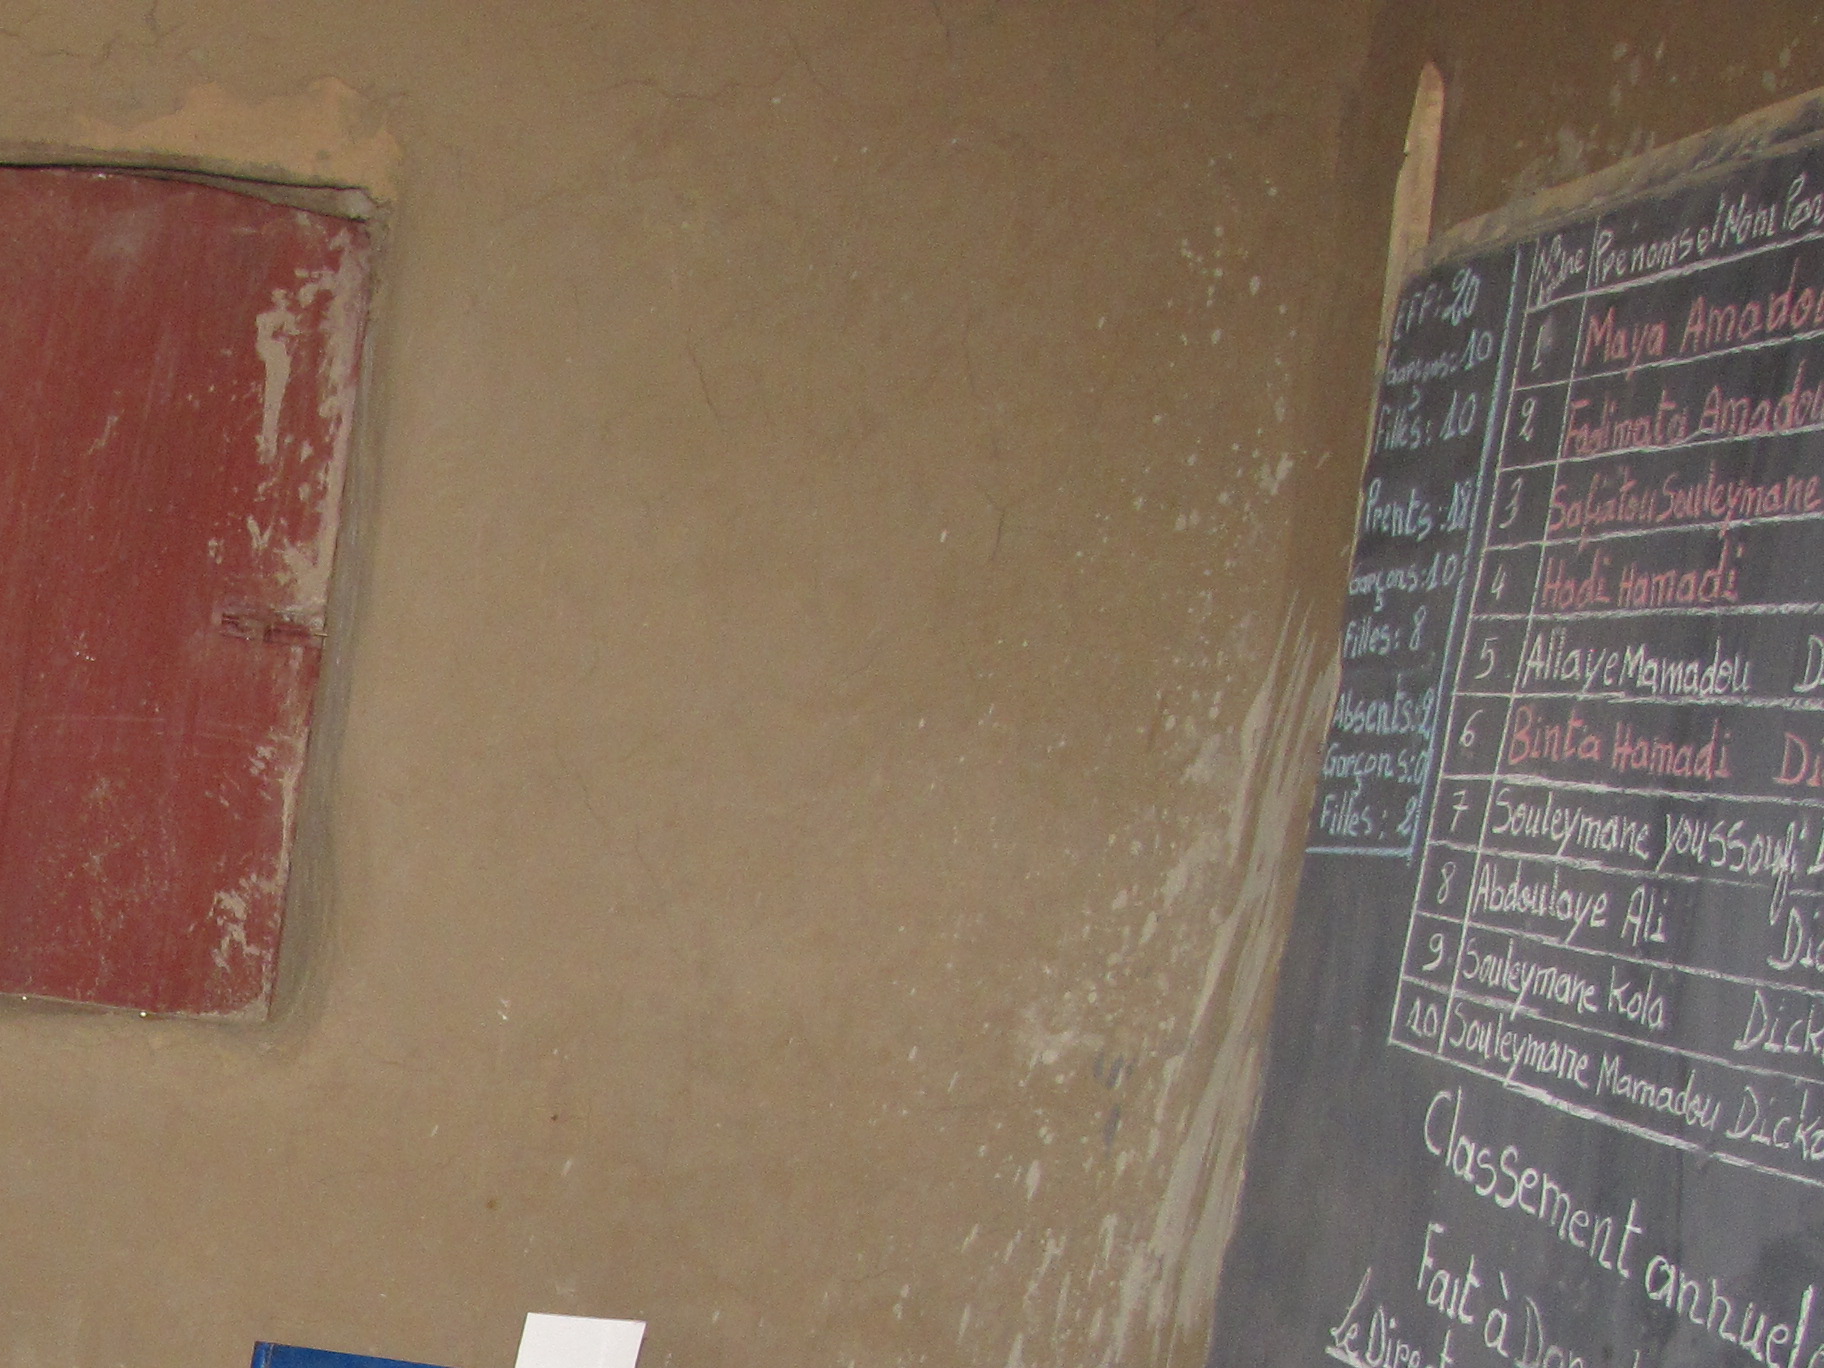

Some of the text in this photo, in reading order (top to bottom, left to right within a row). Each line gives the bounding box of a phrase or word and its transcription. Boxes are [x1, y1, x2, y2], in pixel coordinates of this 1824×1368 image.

[1581, 305, 1668, 383] Maya
[1439, 389, 1477, 441] 10
[1498, 474, 1524, 530] 3
[1490, 535, 1746, 611] 4 Hadi Hamadi
[1408, 604, 1428, 652] 8
[1521, 624, 1620, 702] Allaye
[1457, 708, 1485, 749] 6
[1508, 704, 1603, 767] Binta
[1611, 716, 1733, 782] Hamadi
[1451, 788, 1470, 833] 7
[1491, 786, 1652, 861] Souleymane
[1438, 860, 1458, 905] 8
[1473, 859, 1609, 946] Abdoulaye
[1620, 884, 1670, 948] Ali
[1462, 937, 1598, 1022] Souleymane
[1404, 995, 1440, 1039] 10
[1448, 1000, 1590, 1089] Souleymane
[1423, 1085, 1644, 1280] Classement
[1329, 1265, 1372, 1358] Le
[1416, 1221, 1482, 1326] Fait
[1482, 1269, 1510, 1359] à
